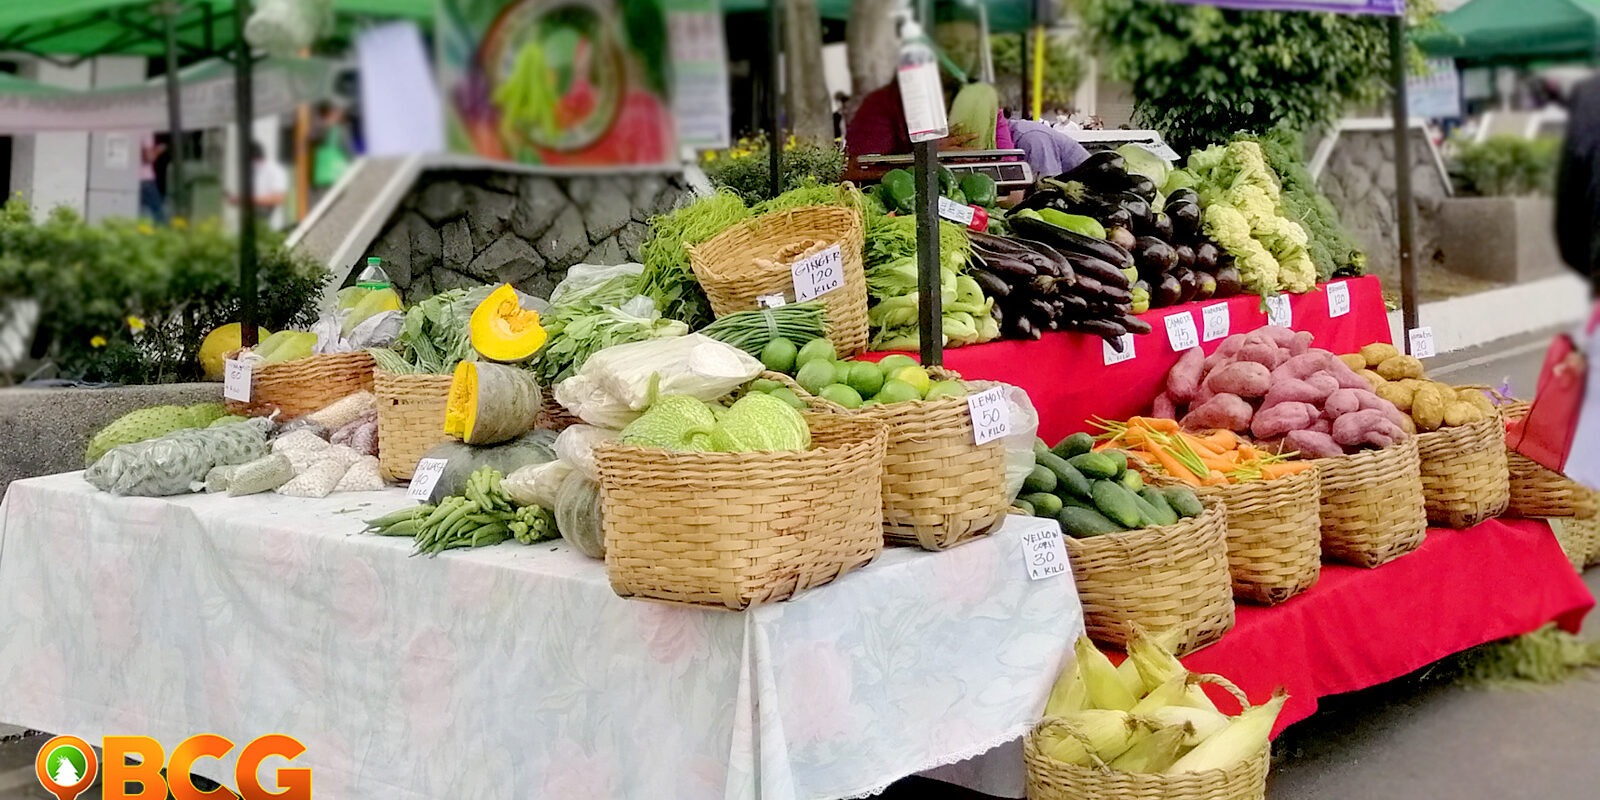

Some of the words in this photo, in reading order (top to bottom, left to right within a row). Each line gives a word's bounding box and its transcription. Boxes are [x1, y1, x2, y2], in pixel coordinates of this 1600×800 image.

[811, 267, 833, 285] 120
[799, 292, 807, 300] A
[814, 280, 838, 296] KILO
[1334, 294, 1346, 306] 120
[1174, 328, 1190, 341] 45
[971, 385, 1007, 409] LEMON
[979, 407, 1001, 428] 50
[979, 430, 986, 439] A
[988, 423, 1006, 437] KILO
[414, 472, 429, 487] 40
[1023, 529, 1059, 547] YELLOW
[1032, 551, 1055, 566] 30
[1032, 569, 1039, 577] A
[1044, 562, 1065, 575] KILO
